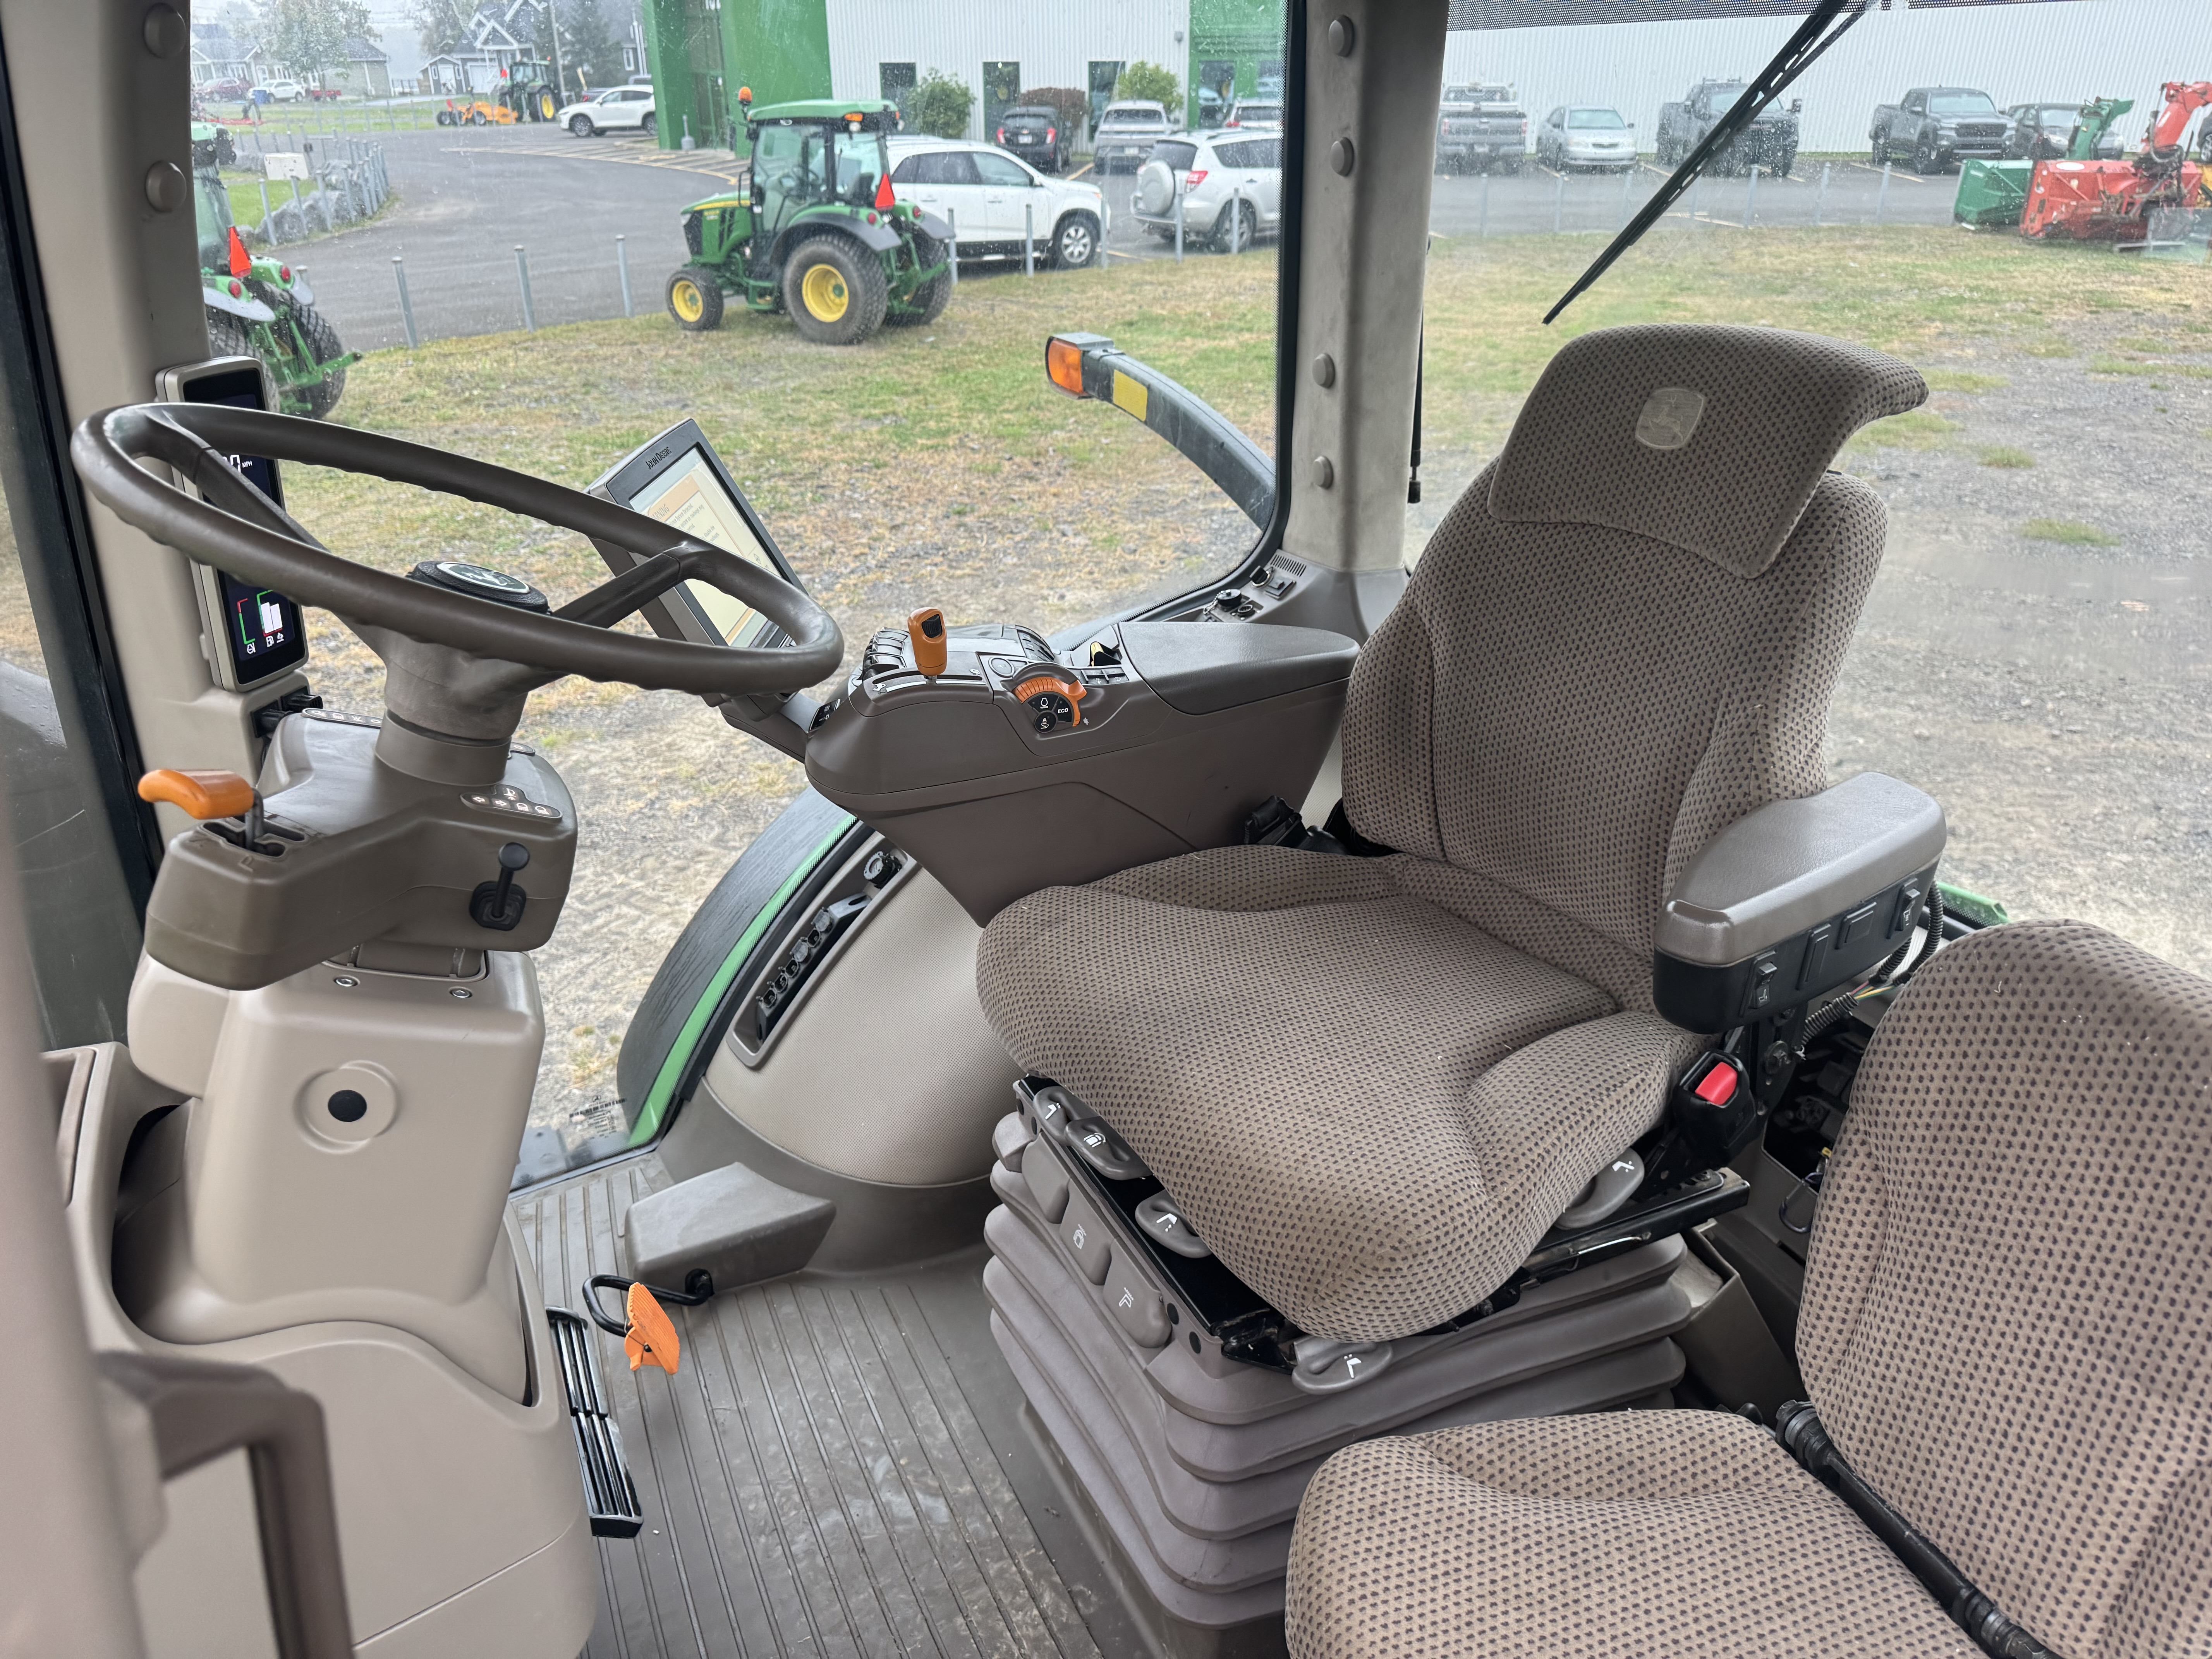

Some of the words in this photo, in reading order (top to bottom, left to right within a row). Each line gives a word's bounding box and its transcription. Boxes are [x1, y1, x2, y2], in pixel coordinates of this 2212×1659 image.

[645, 455, 659, 469] JOHN
[655, 447, 672, 461] DEERE
[651, 504, 670, 520] ARNING
